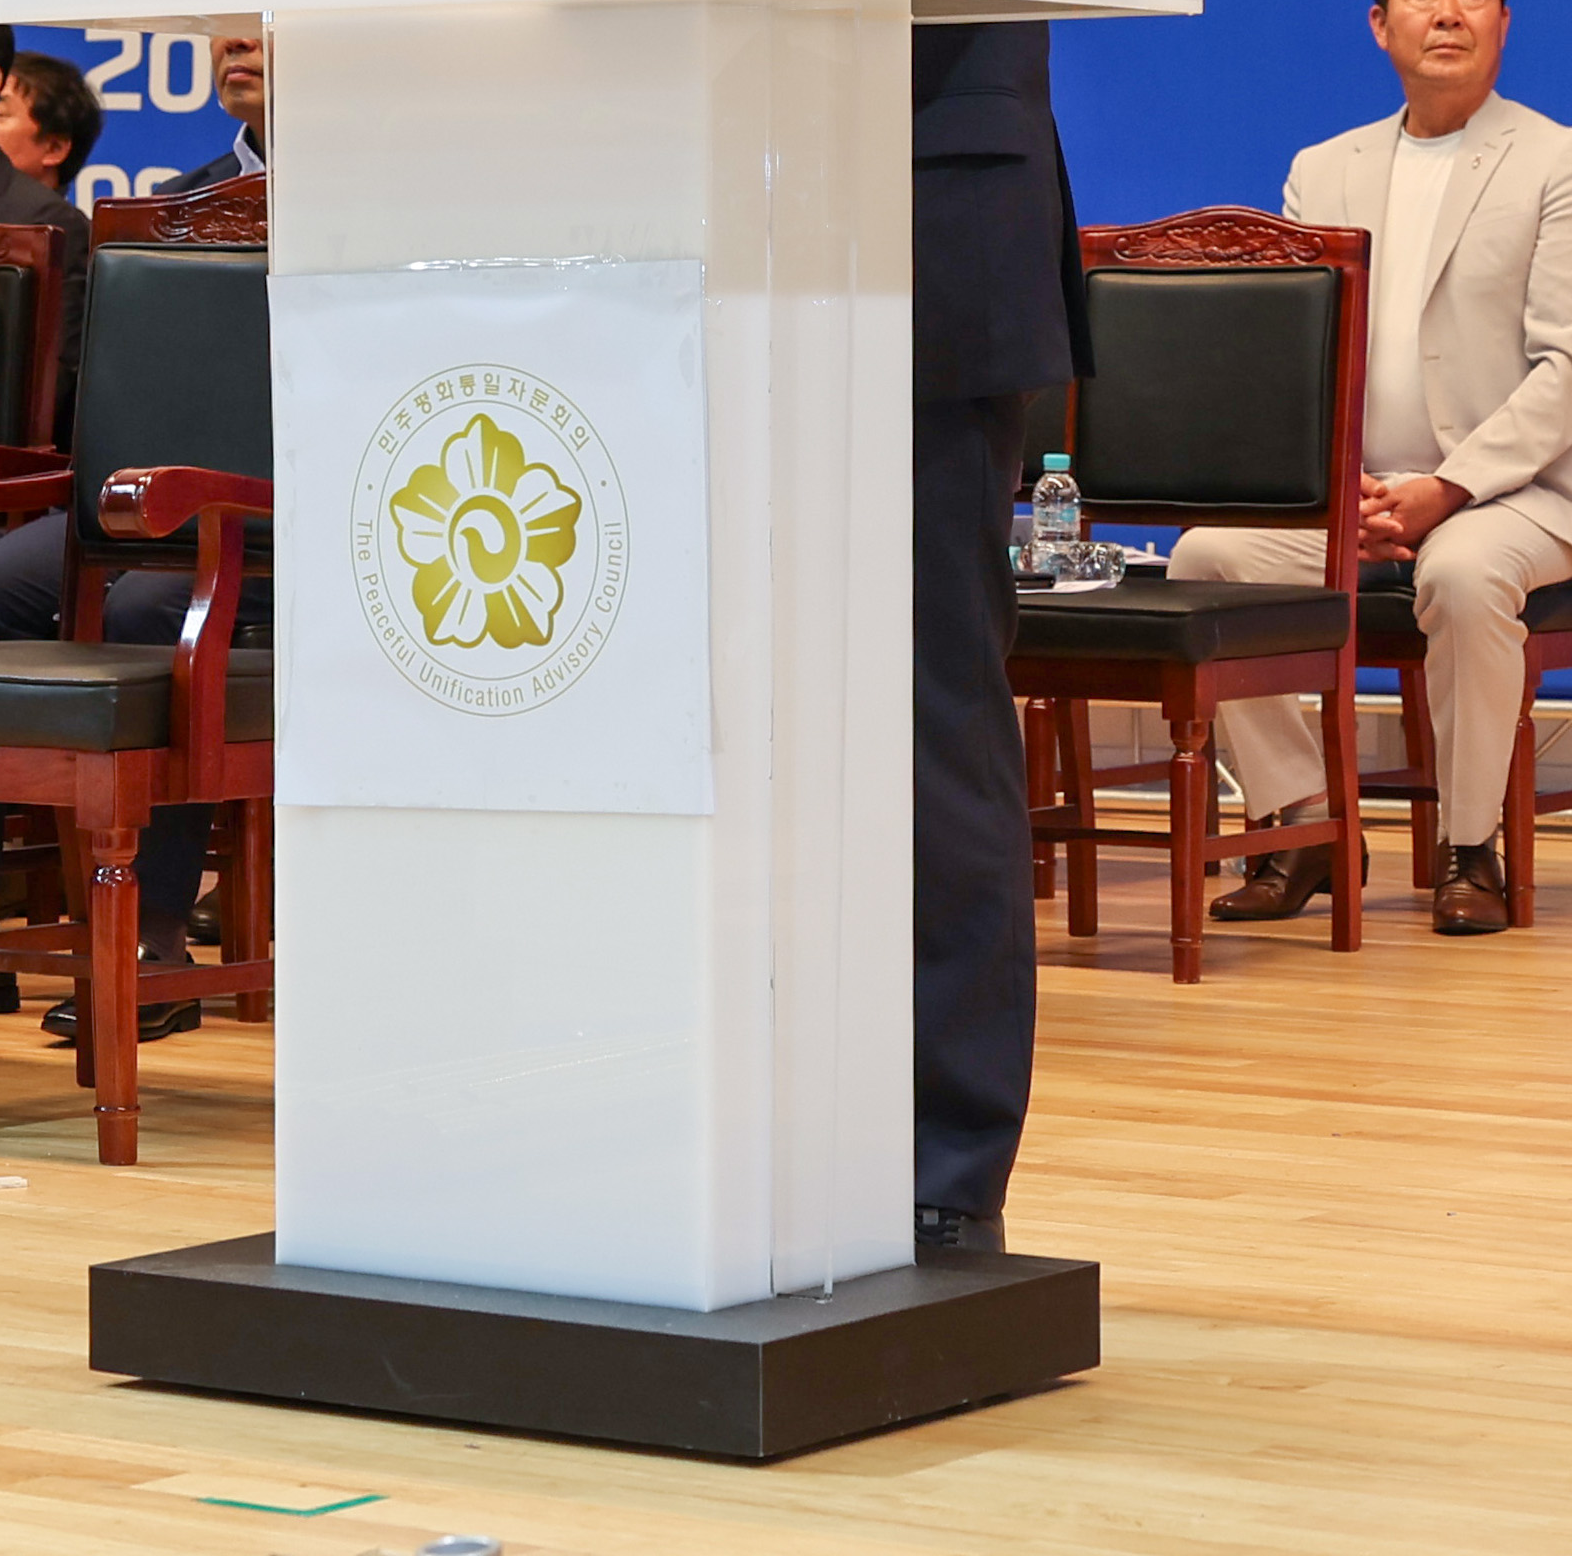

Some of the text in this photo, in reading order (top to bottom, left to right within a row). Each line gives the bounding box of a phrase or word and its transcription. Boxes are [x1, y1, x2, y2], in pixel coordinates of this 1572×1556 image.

[378, 372, 591, 456] 민주평화통일자문회의
[356, 519, 624, 708] The Peaceful Unification Advisory Council
